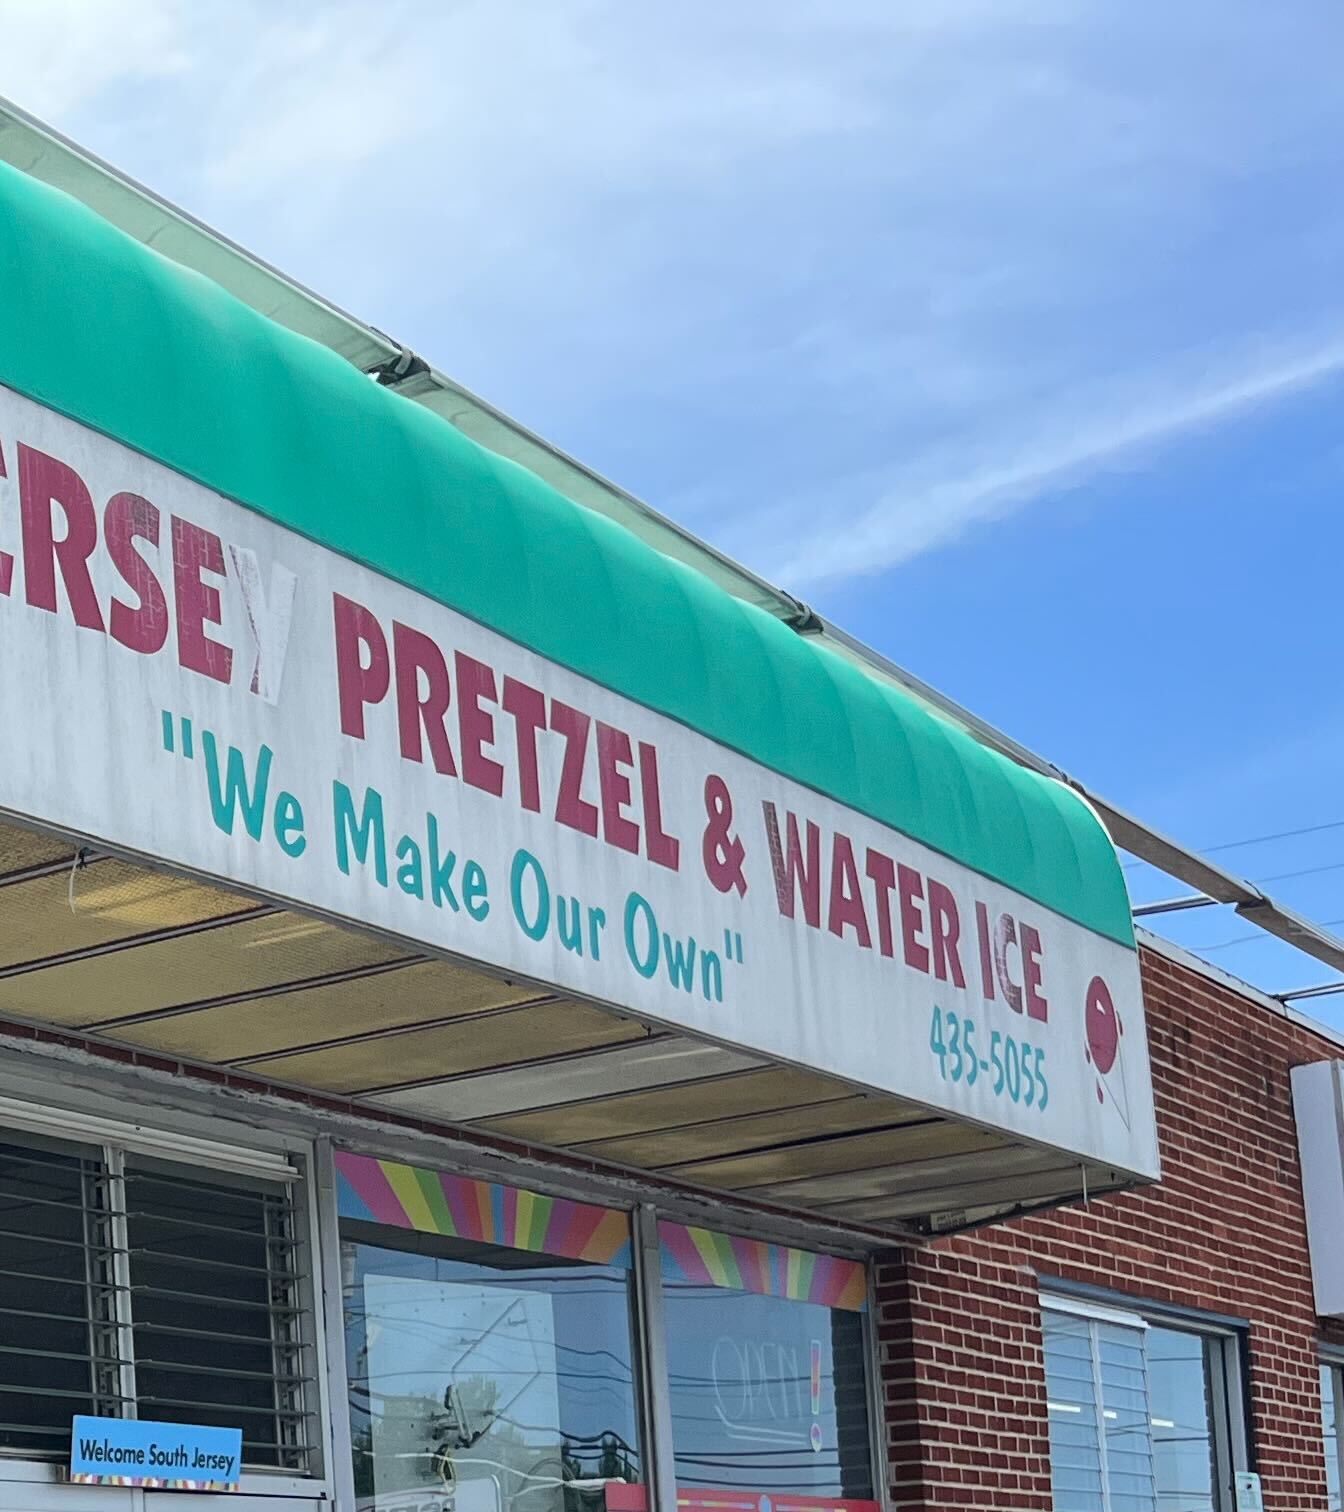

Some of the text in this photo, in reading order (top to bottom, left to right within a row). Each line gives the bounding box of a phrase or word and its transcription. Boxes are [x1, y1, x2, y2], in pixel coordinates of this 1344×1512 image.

[162, 710, 744, 1002] "We Make Our Own"
[333, 592, 679, 872] PRETZEL
[703, 774, 747, 898] &
[762, 800, 965, 990] WATER
[976, 901, 1048, 1023] ICE
[929, 1005, 1049, 1113] 435-5055
[79, 1438, 235, 1476] Welcome South Jersey
